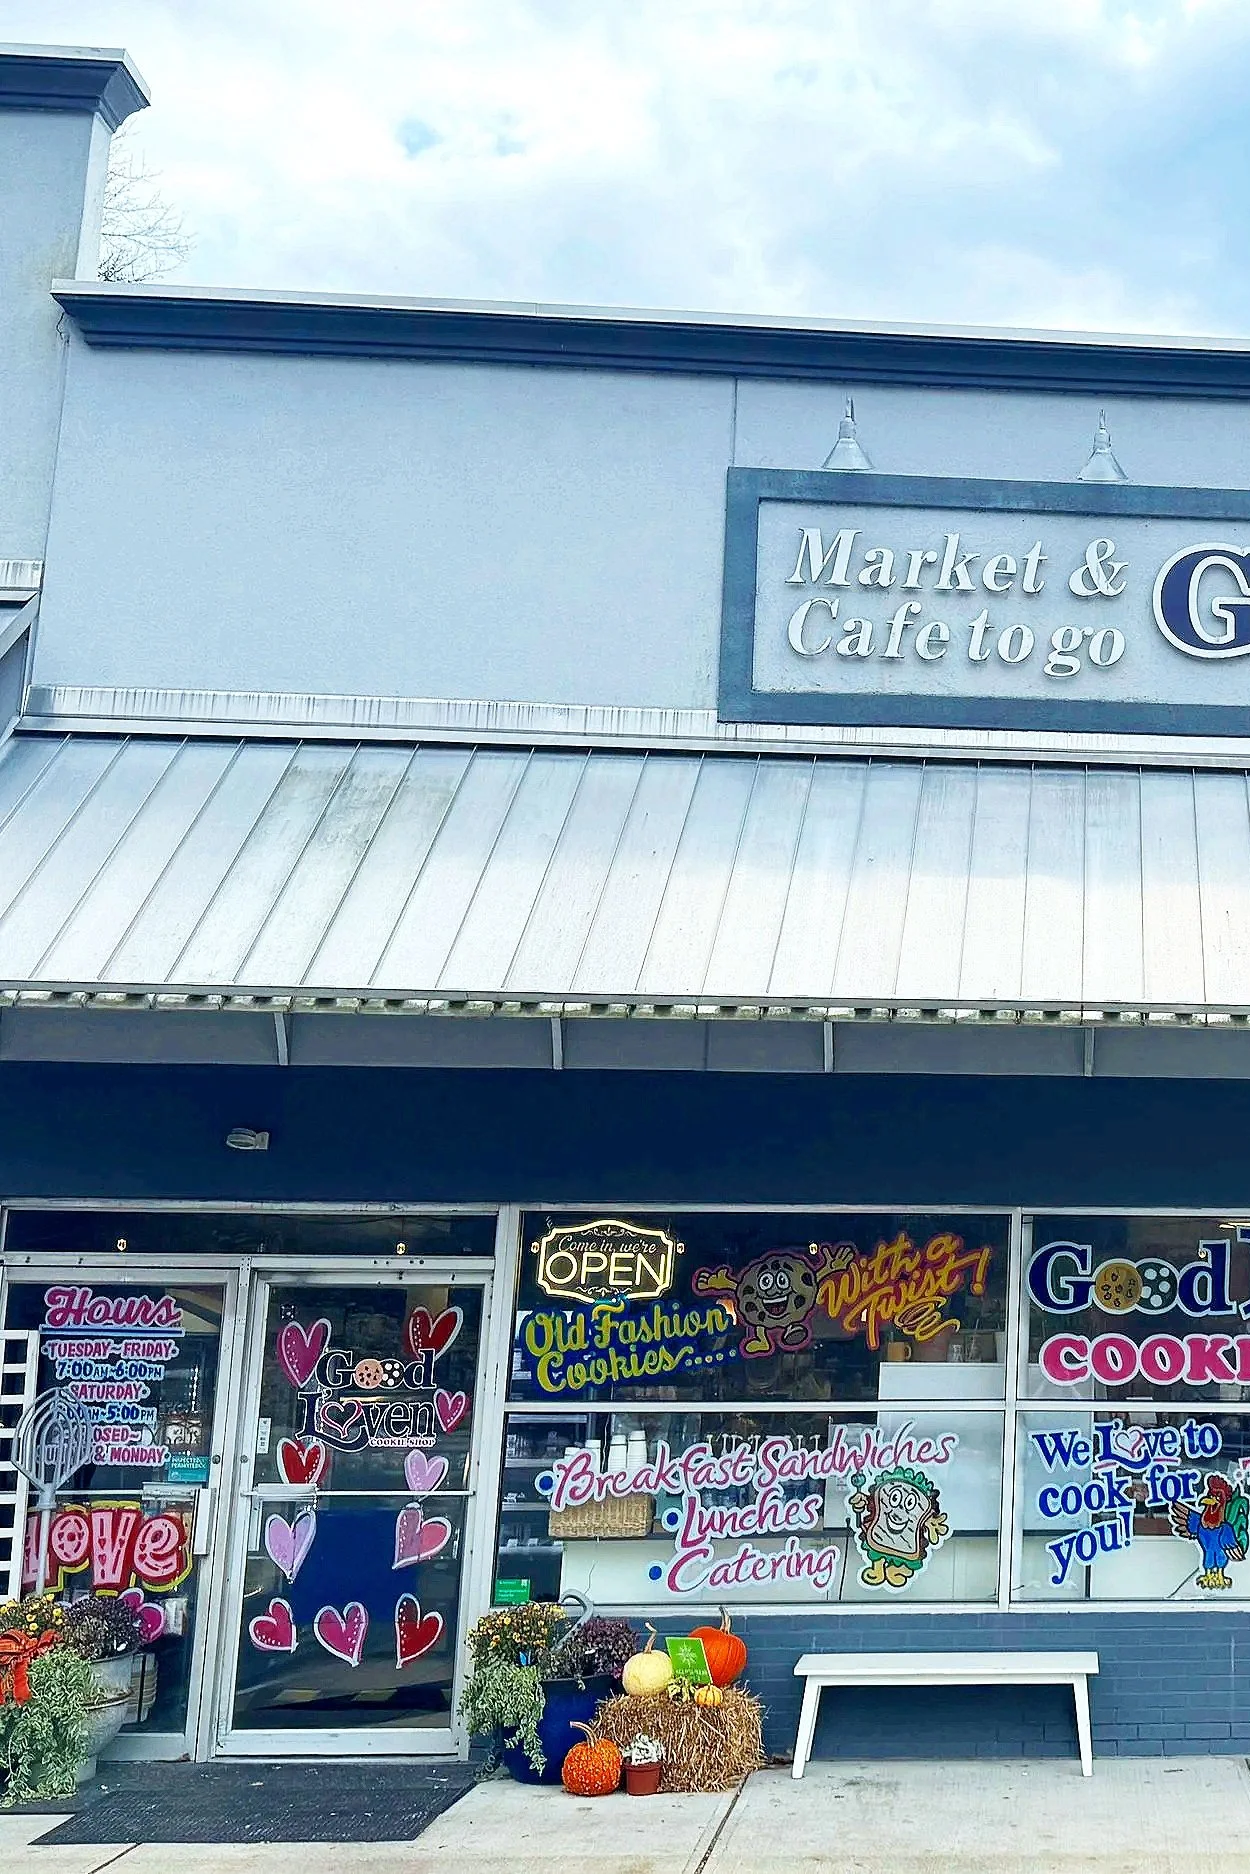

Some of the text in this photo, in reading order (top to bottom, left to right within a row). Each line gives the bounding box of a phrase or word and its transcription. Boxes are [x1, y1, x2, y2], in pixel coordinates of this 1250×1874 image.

[786, 528, 1129, 597] Market &
[787, 598, 1125, 678] Cafe to go
[546, 1251, 665, 1286] OPEN
[559, 1236, 596, 1251] Come
[620, 1240, 657, 1253] we're
[816, 1232, 961, 1318] With a
[1029, 1241, 1236, 1316] Good
[45, 1287, 182, 1327] Hours
[525, 1300, 730, 1357] Old Fashion
[71, 1383, 142, 1400] SATURDAY
[316, 1348, 437, 1390] Good
[94, 1446, 105, 1462] &
[110, 1446, 165, 1463] MONDAY
[370, 1437, 436, 1447] COOKIE SHOP
[552, 1421, 957, 1508] Breakfast Sandwiches
[1032, 1431, 1090, 1468] We
[1184, 1420, 1219, 1454] to
[1039, 1464, 1198, 1517] cook for
[680, 1490, 819, 1548] Lunches
[667, 1538, 836, 1593] Catering
[1049, 1511, 1131, 1585] you!
